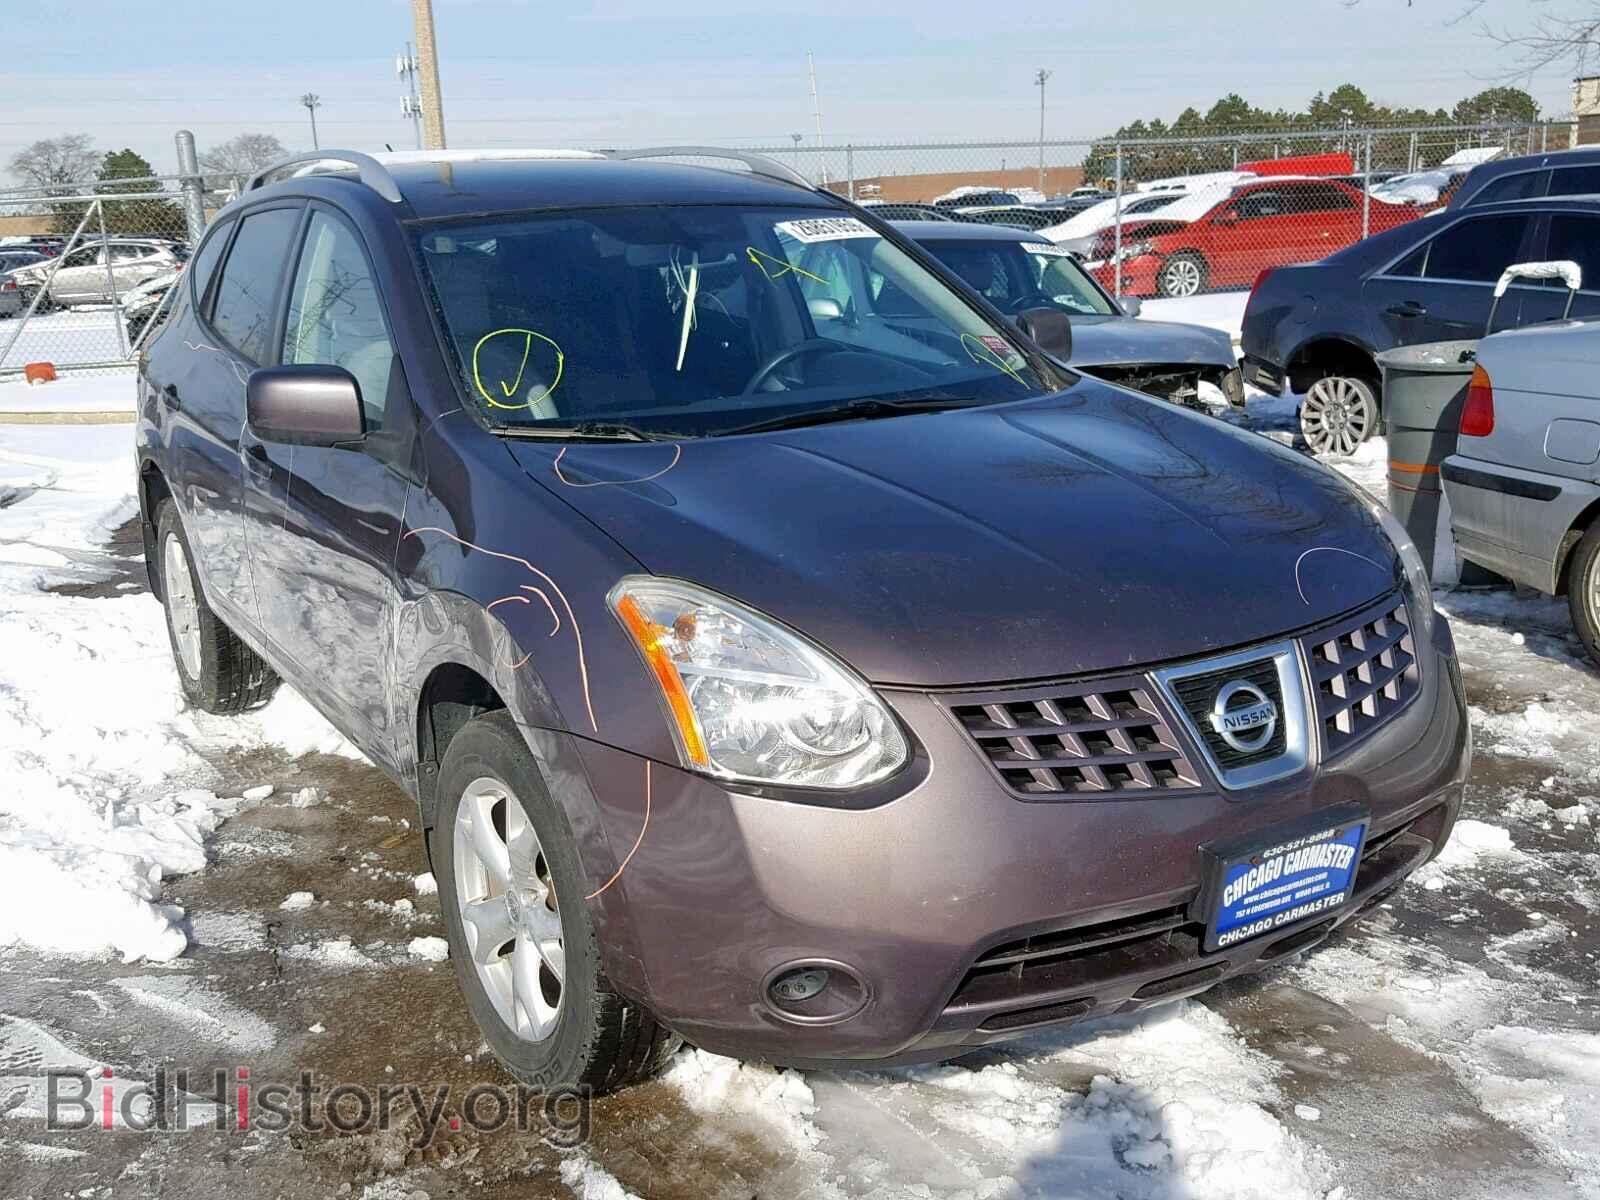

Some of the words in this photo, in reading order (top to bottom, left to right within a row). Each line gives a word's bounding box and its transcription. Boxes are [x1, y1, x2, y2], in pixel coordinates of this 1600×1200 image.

[1223, 705, 1274, 729] NISSAN
[1223, 855, 1284, 908] CHICAGO
[1283, 843, 1356, 877] CARMASTER
[1218, 918, 1273, 946] CHICAGO
[1274, 892, 1345, 926] CARMASTER
